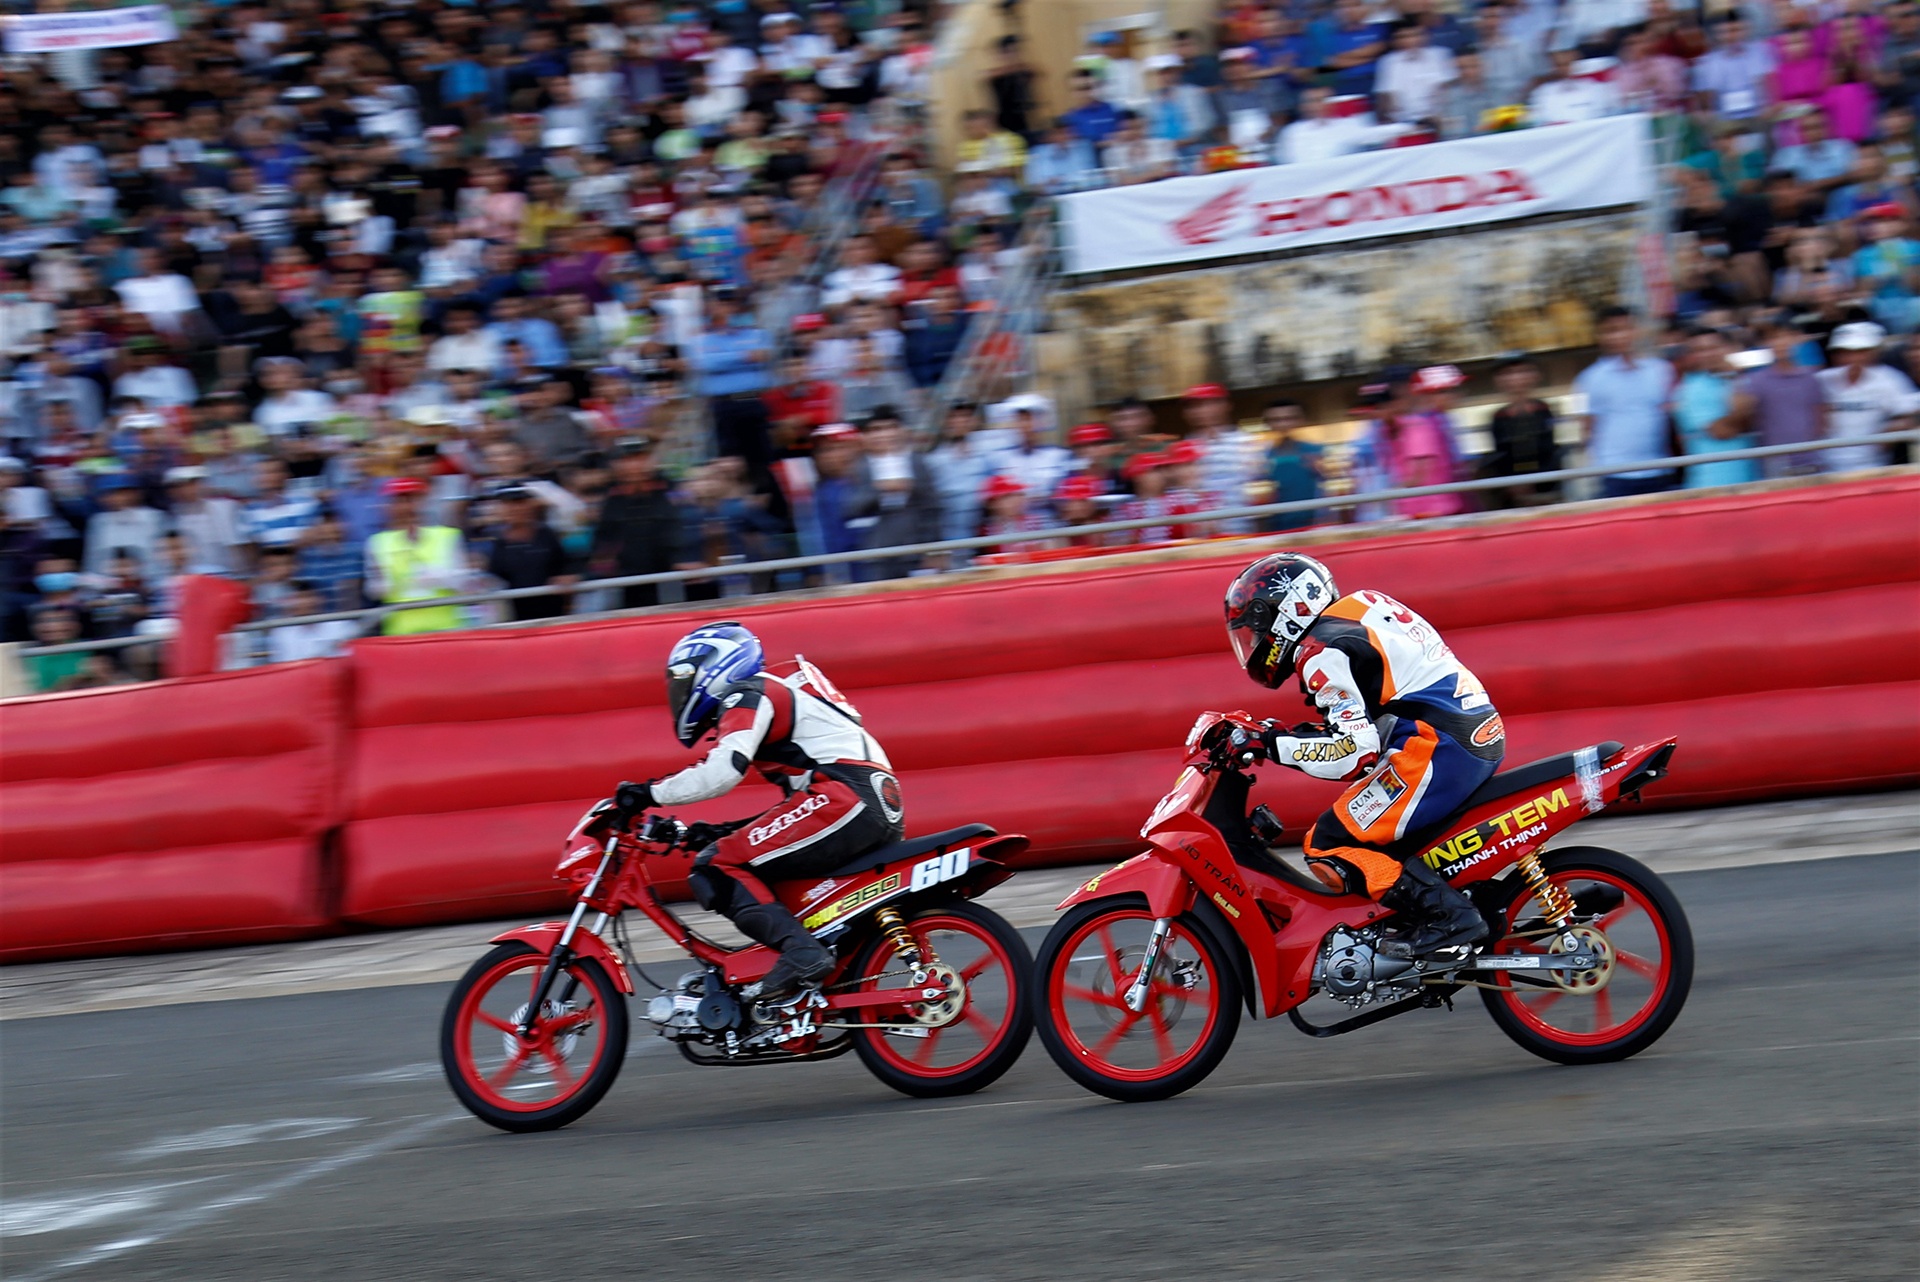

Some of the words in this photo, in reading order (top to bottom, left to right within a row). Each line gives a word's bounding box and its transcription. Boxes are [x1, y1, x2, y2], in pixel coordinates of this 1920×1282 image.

[1254, 169, 1540, 237] HONDA
[1350, 789, 1375, 814] SUM
[1357, 799, 1383, 822] racing
[1488, 787, 1571, 837] TEM
[910, 847, 971, 893] 60
[1444, 845, 1499, 877] THANH
